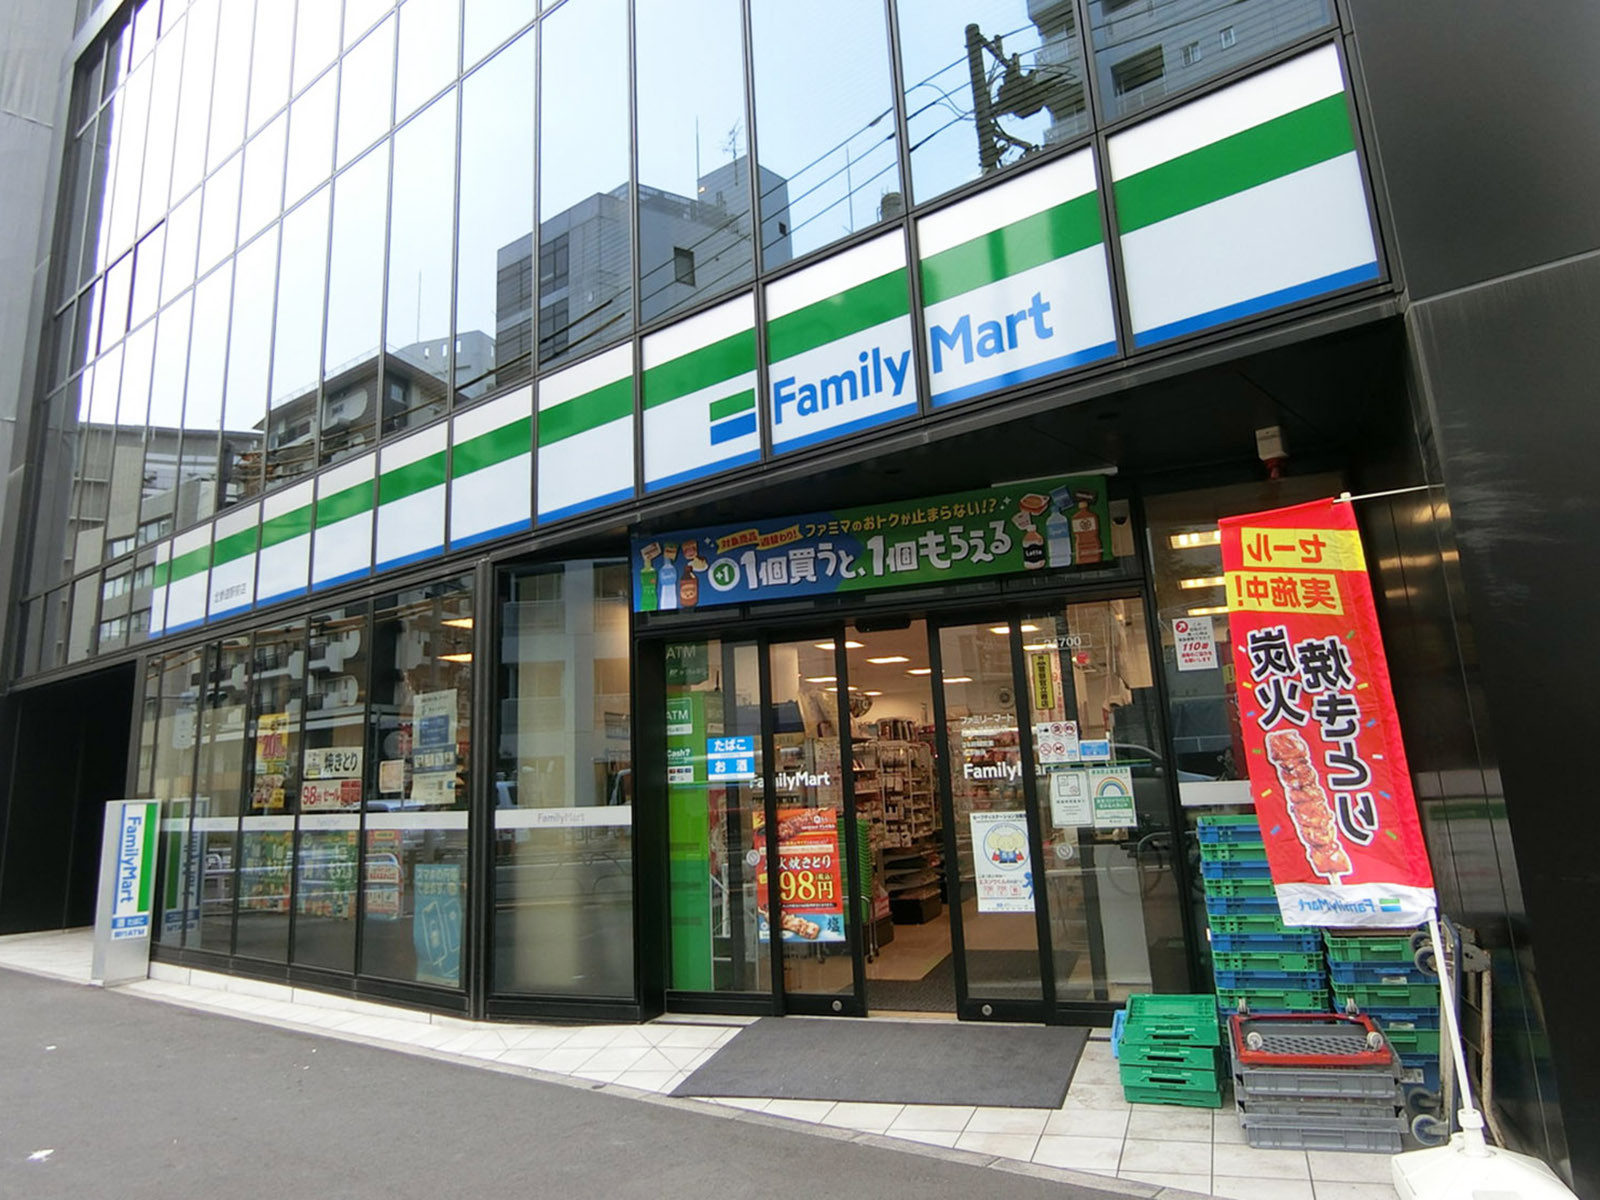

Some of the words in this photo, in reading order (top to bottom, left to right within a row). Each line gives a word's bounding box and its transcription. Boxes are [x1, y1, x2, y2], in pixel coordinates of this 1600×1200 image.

[665, 645, 696, 659] ATM
[714, 739, 746, 752] たばこ
[323, 751, 358, 774] 焼きとり
[749, 771, 830, 791] FailyMart
[120, 816, 142, 904] FamilyMart
